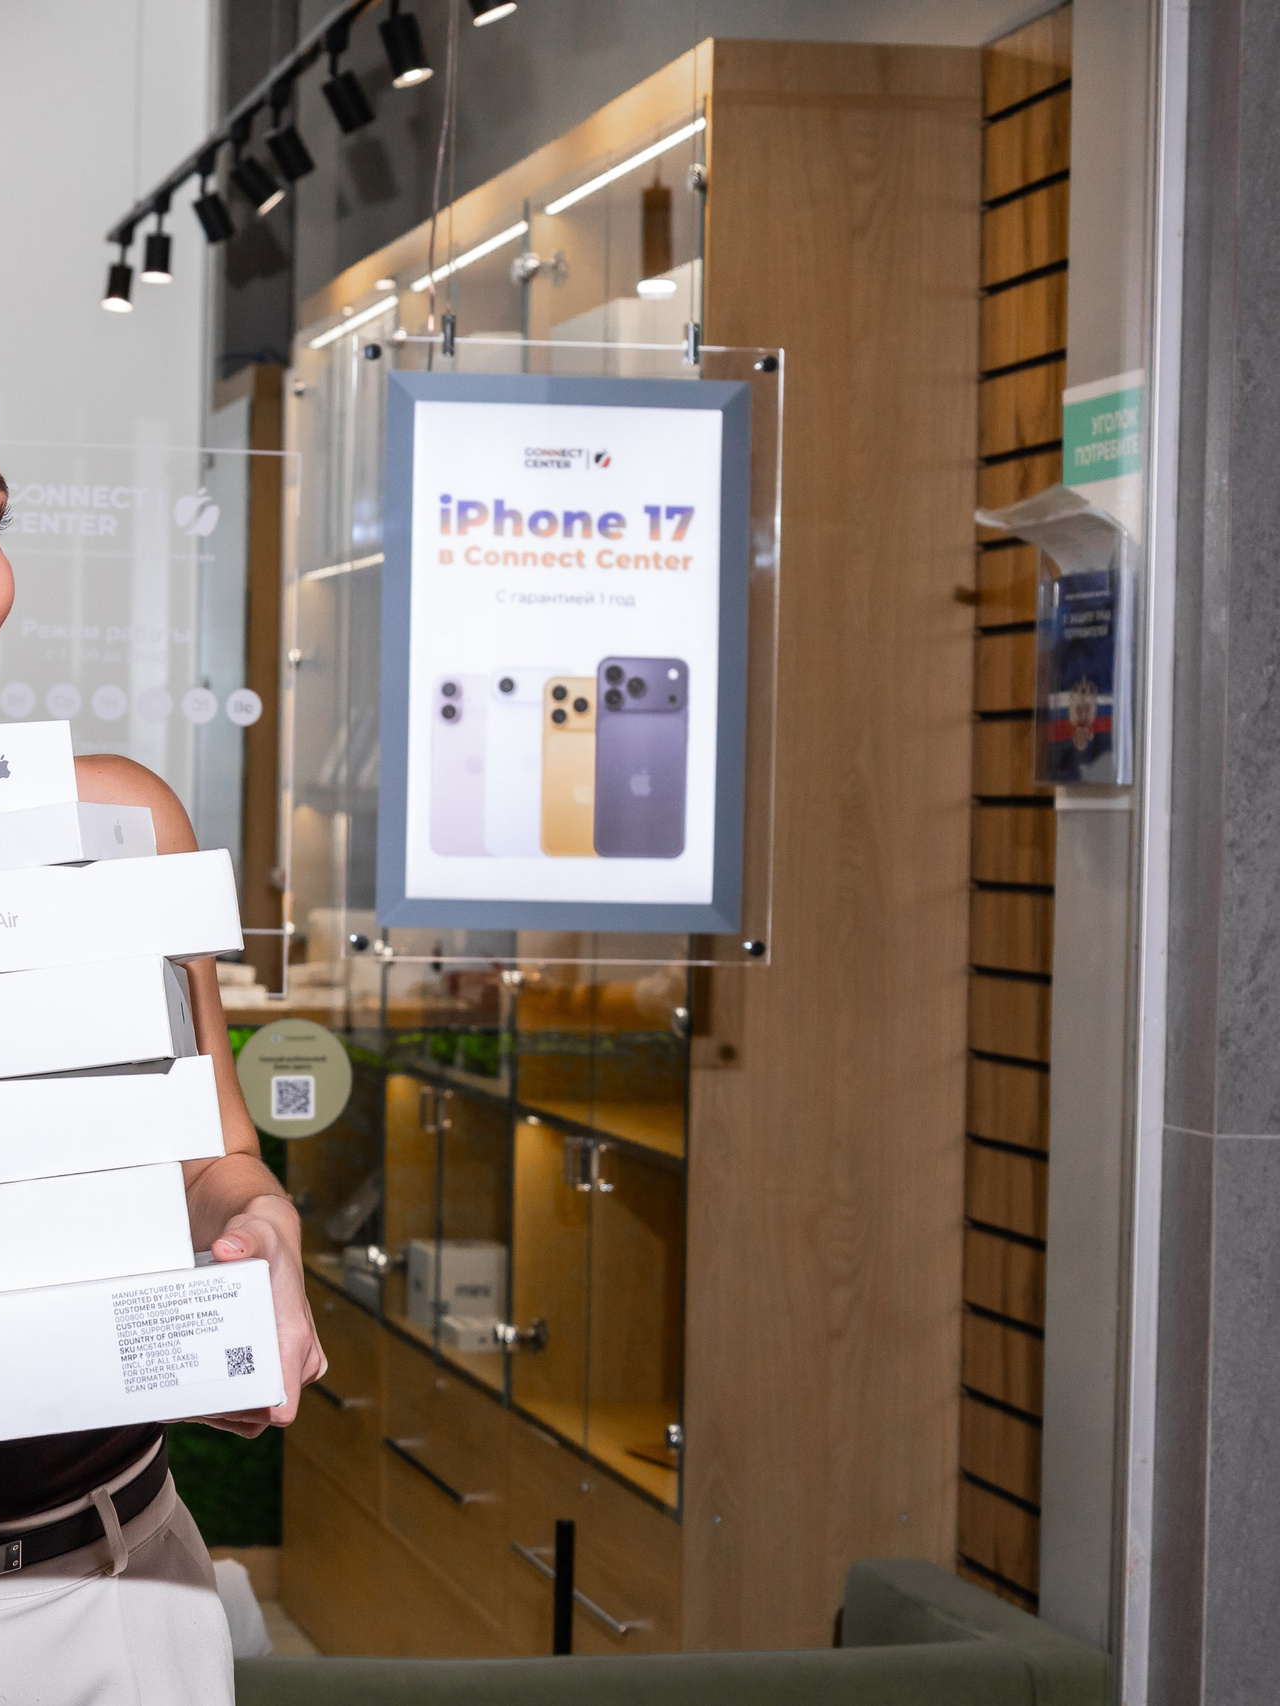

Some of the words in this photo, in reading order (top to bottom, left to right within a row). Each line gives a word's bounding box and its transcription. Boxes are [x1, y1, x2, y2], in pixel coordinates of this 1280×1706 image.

[525, 447, 582, 458] CONNECT
[525, 459, 571, 469] CENTER
[439, 494, 626, 540] iPhone
[644, 505, 695, 541] 17
[439, 550, 453, 564] в
[465, 546, 585, 568] Connect
[596, 550, 692, 571] Center
[496, 590, 508, 604] С
[512, 591, 594, 607] гарантией
[600, 592, 606, 605] 1
[609, 594, 635, 608] год
[112, 1285, 174, 1300] MANUFACTURED
[188, 1280, 211, 1288] APPLE
[113, 1296, 151, 1307] IMPORTED
[165, 1291, 186, 1299] APPLE
[189, 1288, 209, 1296] INDIA
[210, 1285, 227, 1293] PVT.
[114, 1304, 155, 1315] CUSTOMER
[158, 1298, 192, 1309] SUPPORT
[195, 1291, 238, 1302] TELEPHONE
[115, 1313, 144, 1323] 000800
[147, 1308, 179, 1318] 1009009
[116, 1319, 158, 1331] CUSTOMER
[160, 1313, 194, 1324] SUPPORT
[197, 1310, 220, 1318] EMAIL
[118, 1336, 154, 1346] COUNTRY
[168, 1330, 194, 1339] ORIGIN
[195, 1326, 219, 1335] CHINA
[120, 1346, 135, 1354] SKU
[121, 1354, 137, 1362] MRP
[145, 1348, 182, 1358] 99900.00
[122, 1362, 145, 1370] (INCL.
[157, 1356, 170, 1364] ALL
[171, 1353, 198, 1363] TAXES)
[123, 1369, 137, 1377] FOR
[139, 1365, 164, 1375] OTHER
[166, 1360, 199, 1371] RELATED
[125, 1384, 146, 1393] SCAN
[147, 1382, 157, 1390] QR
[160, 1378, 179, 1388] CODE
